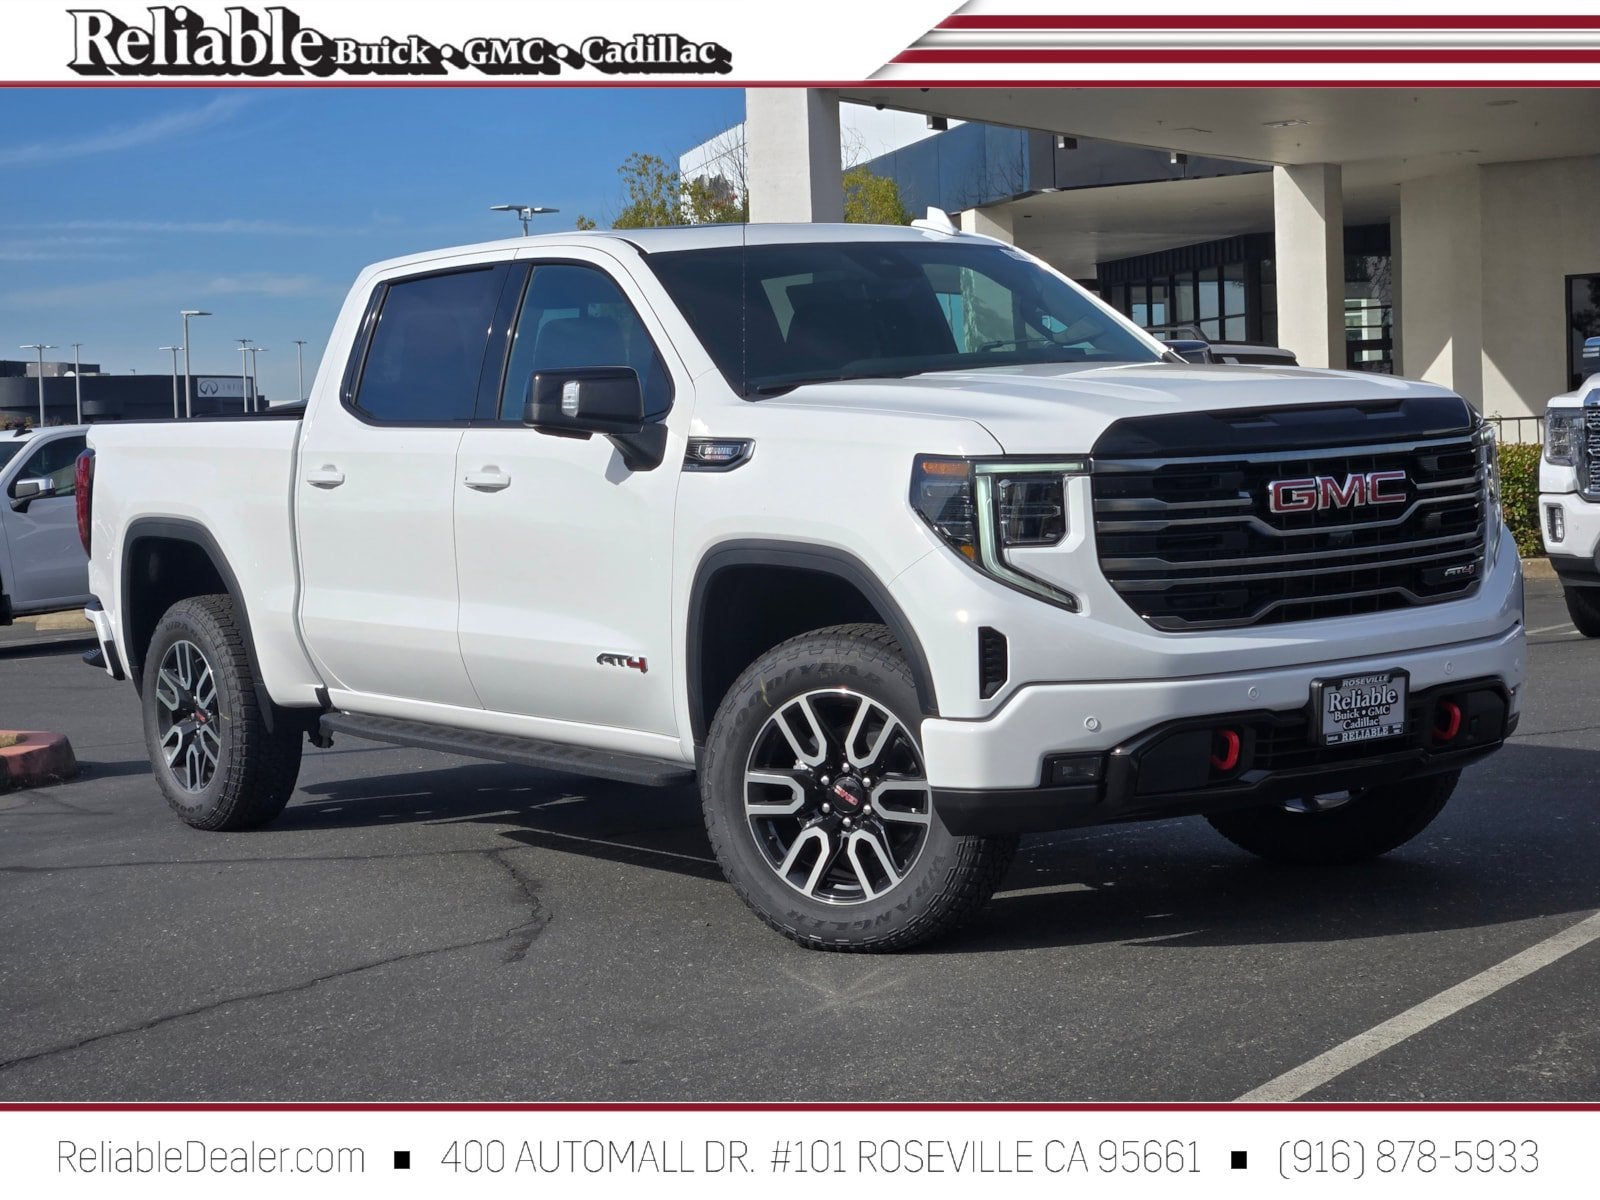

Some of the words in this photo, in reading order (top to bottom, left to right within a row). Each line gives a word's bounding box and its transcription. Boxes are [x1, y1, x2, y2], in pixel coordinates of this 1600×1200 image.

[1268, 470, 1407, 514] GMC
[1444, 564, 1475, 577] AT4
[596, 652, 649, 675] AT4
[1342, 674, 1390, 687] ROSEVILLE
[1328, 684, 1398, 712] Reliable
[1333, 708, 1361, 722] Buick
[1367, 704, 1391, 717] GMC
[1342, 715, 1380, 731] Cadillac
[1341, 725, 1389, 742] RELIABLE
